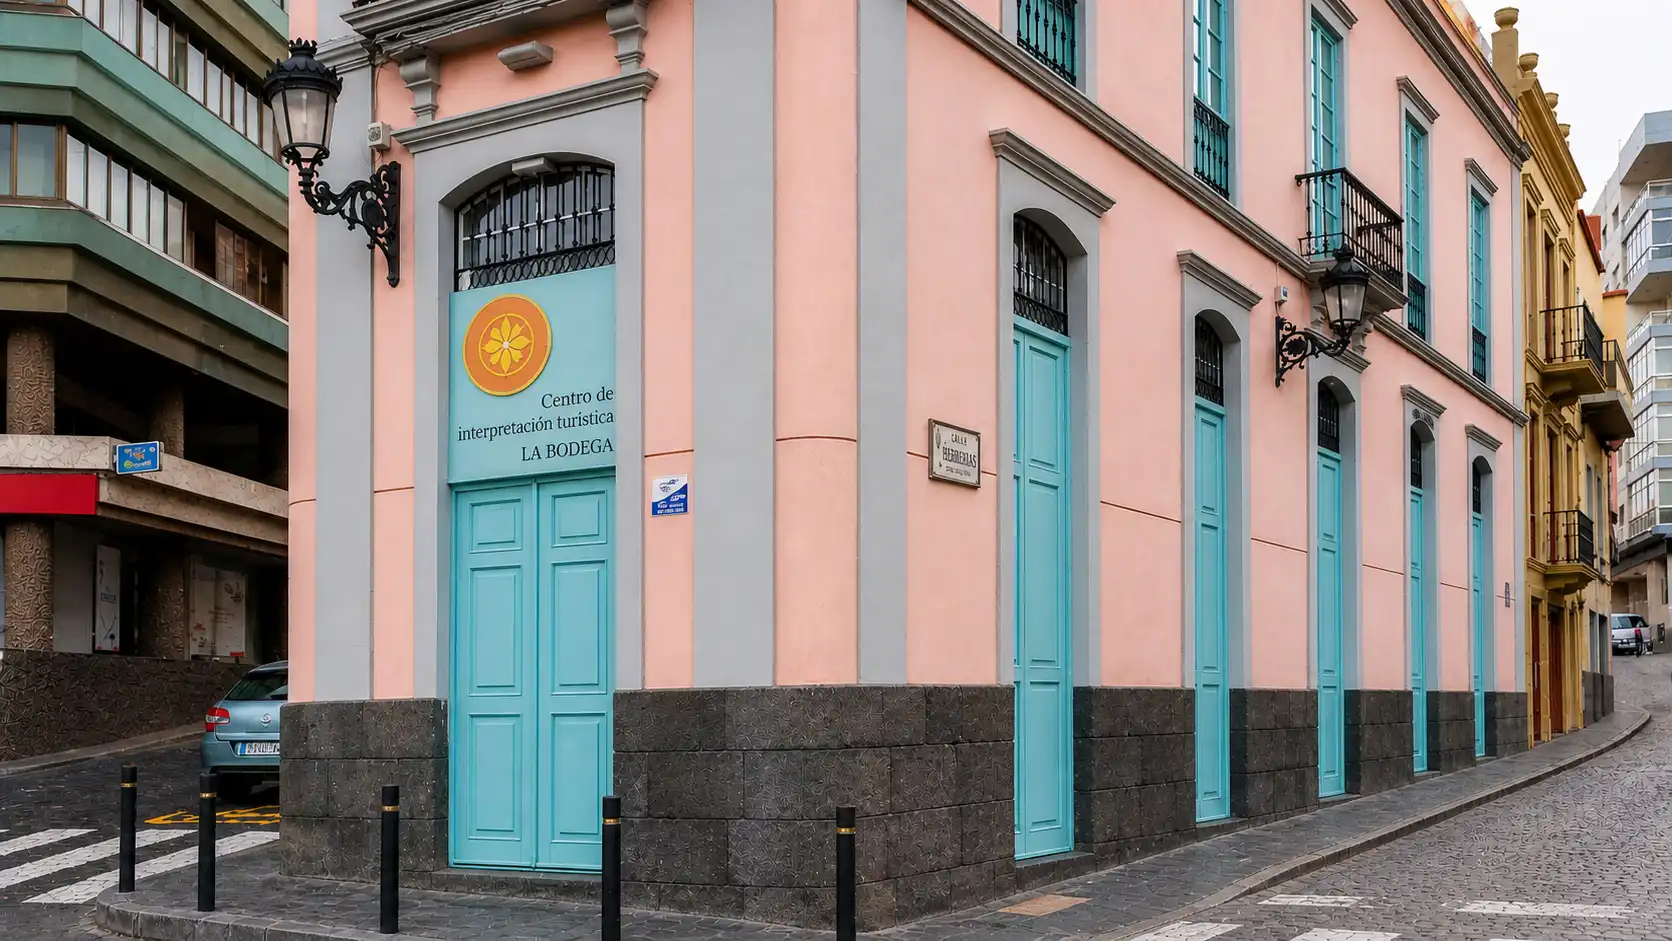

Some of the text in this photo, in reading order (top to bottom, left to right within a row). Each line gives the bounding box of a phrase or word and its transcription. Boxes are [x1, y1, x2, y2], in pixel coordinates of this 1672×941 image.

[541, 386, 614, 409] Centro de
[458, 410, 614, 442] interpretación turística
[521, 438, 615, 461] LA BODEGA
